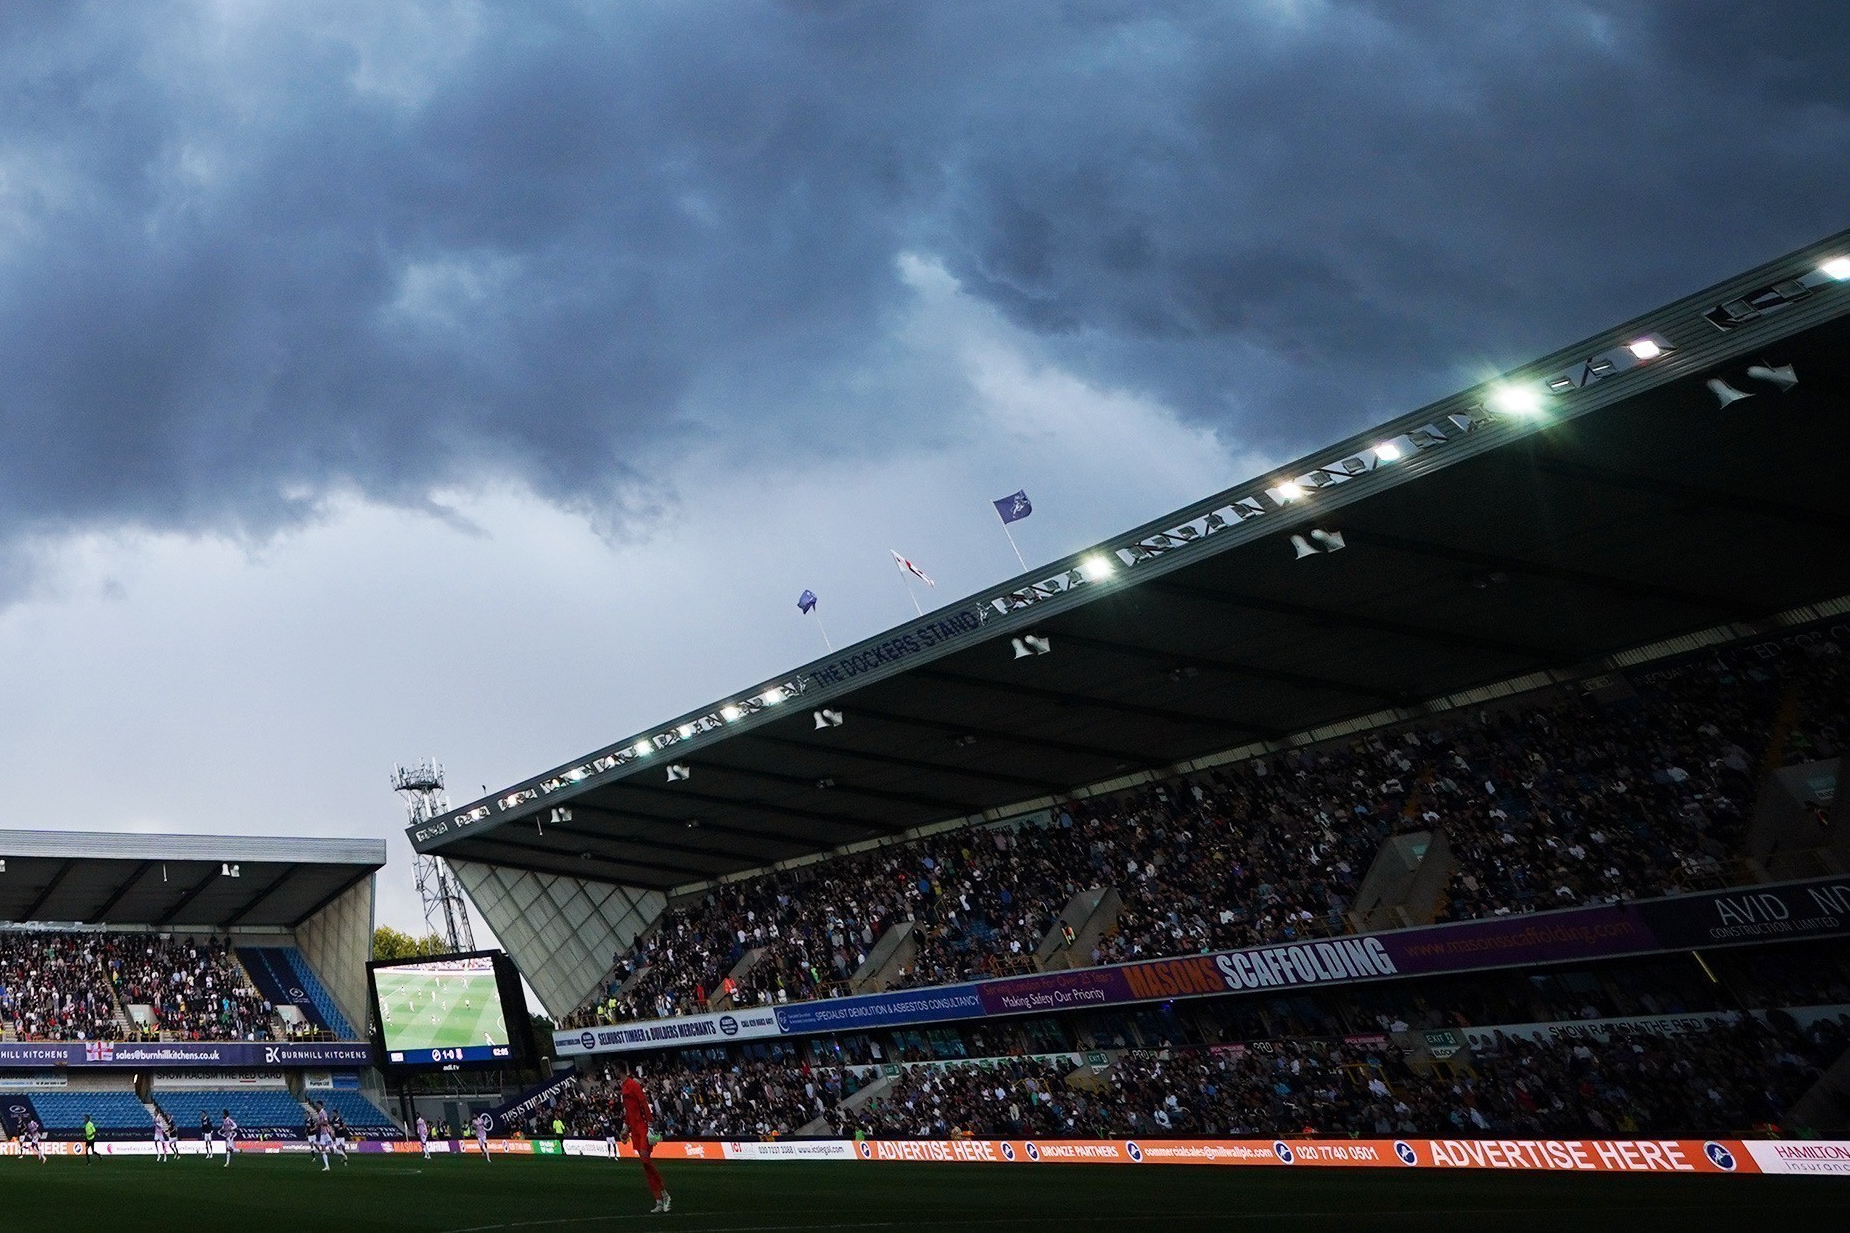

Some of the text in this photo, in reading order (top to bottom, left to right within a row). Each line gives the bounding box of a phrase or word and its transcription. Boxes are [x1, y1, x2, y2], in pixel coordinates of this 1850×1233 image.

[809, 611, 980, 688] THE DOCKERS STAND
[1714, 893, 1789, 926] AVID
[1709, 916, 1840, 939] CONSTRUCTION LIMITED
[1122, 937, 1398, 999] MASONS SCAFFOLDING
[1056, 975, 1081, 988] Over
[1002, 987, 1105, 1009] Making Safety Our Priority
[814, 1008, 849, 1022] SPECIALIST
[849, 1007, 888, 1019] DEMOLITION
[893, 1001, 928, 1015] ASBESTOS
[928, 996, 980, 1011] CONSULTANCY
[597, 1029, 624, 1046] SELHURST
[624, 1028, 647, 1044] TIMBER
[650, 1024, 678, 1041] BUILDERS
[679, 1020, 717, 1038] MERCHANTS
[1640, 1018, 1670, 1033] THE
[1426, 1033, 1444, 1043] EXIT
[23, 1050, 68, 1058] KITCHENS
[115, 1050, 220, 1061] sales@burnhillkitchens.co.uk
[281, 1051, 322, 1059] BURNHILL
[324, 1051, 367, 1059] KITCHENS
[156, 1071, 282, 1080] SHOW RACISM THE RED CARD
[500, 1075, 578, 1123] THIS IS THE LIONS' DEN
[393, 1141, 423, 1153] MASONS
[877, 1140, 998, 1161] ADVERTISE HERE
[1040, 1144, 1119, 1158] BRONZE PARTNERS
[1144, 1146, 1273, 1160] commercialsales@millwallplc.com
[1295, 1145, 1379, 1160] 020 7740 0501
[1774, 1145, 1850, 1159] HAMILTON
[1429, 1140, 1694, 1170] ADVERTISE HERE
